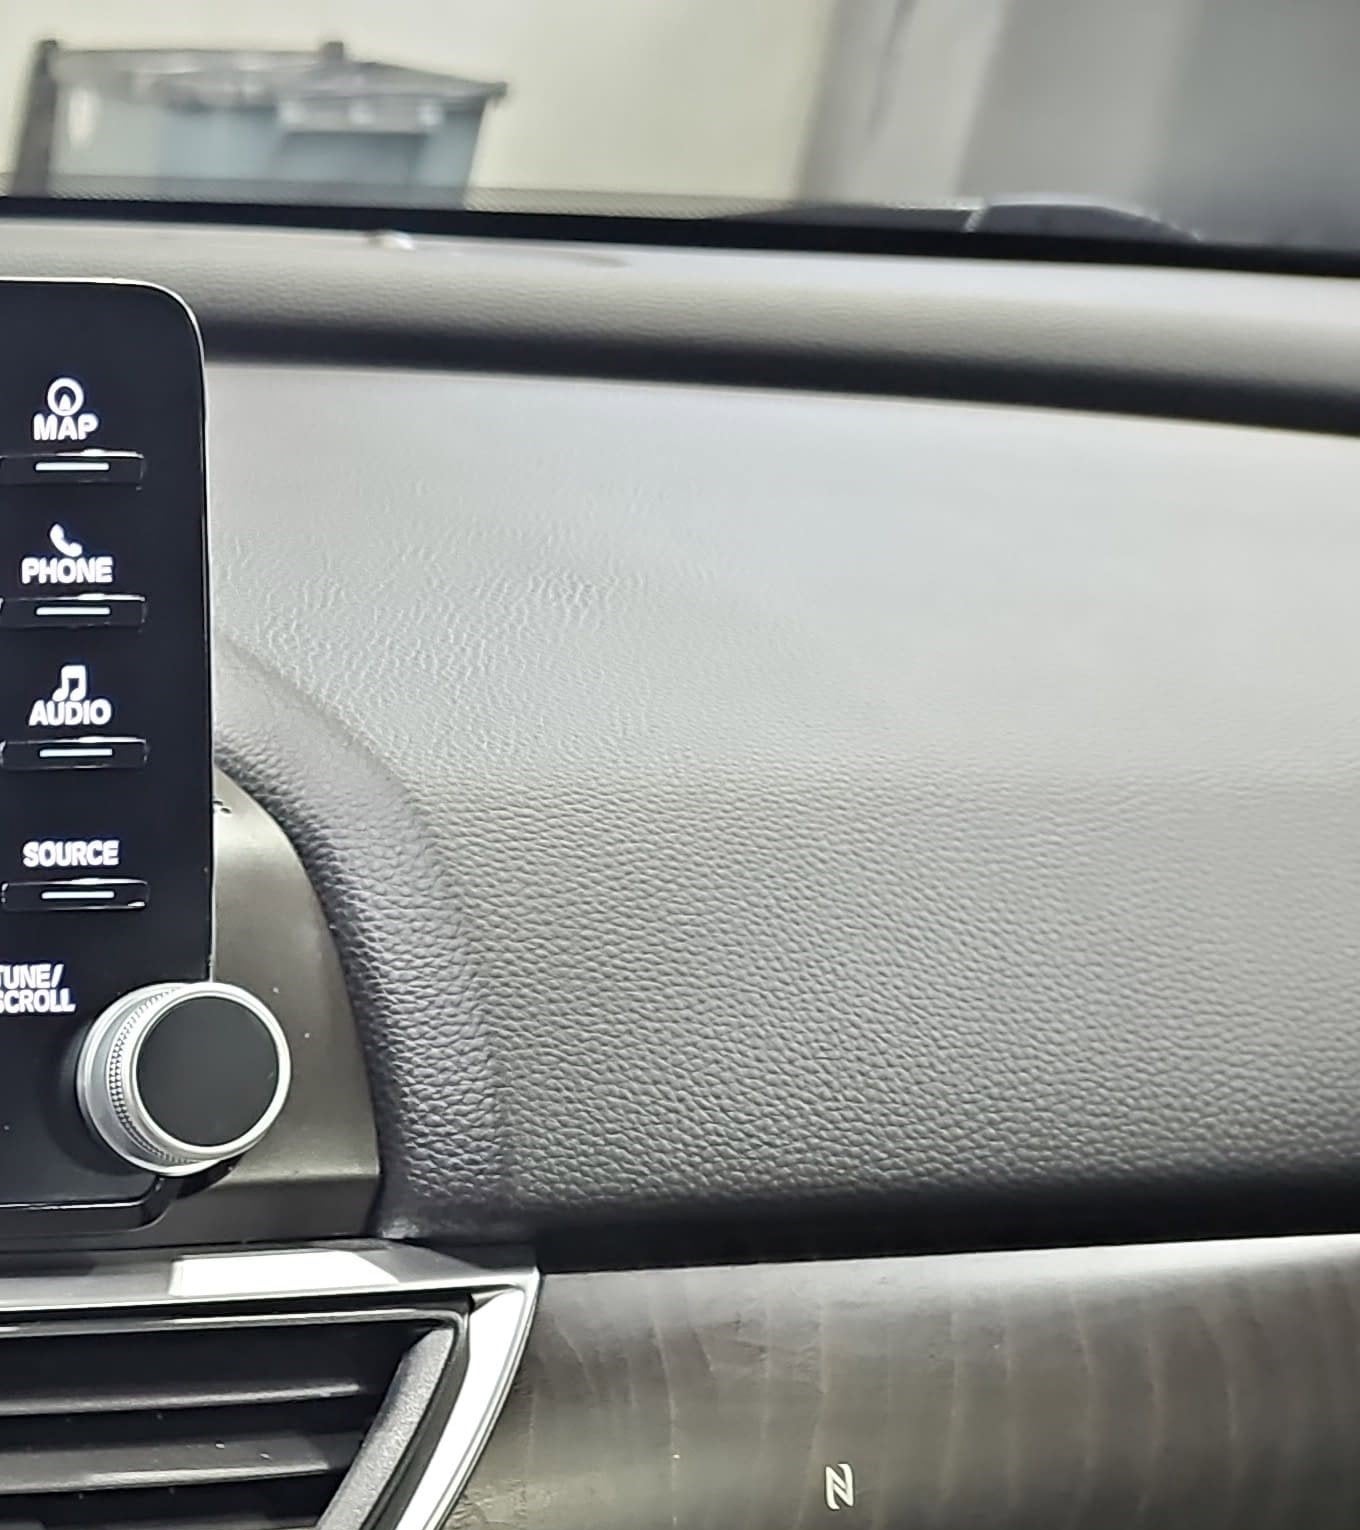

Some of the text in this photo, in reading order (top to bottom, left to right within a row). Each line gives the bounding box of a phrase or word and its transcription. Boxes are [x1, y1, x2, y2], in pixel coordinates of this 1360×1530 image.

[33, 413, 99, 440] MAP
[21, 556, 114, 584] PHONE
[28, 699, 112, 726] AUDIO
[22, 839, 120, 867] SOURCE
